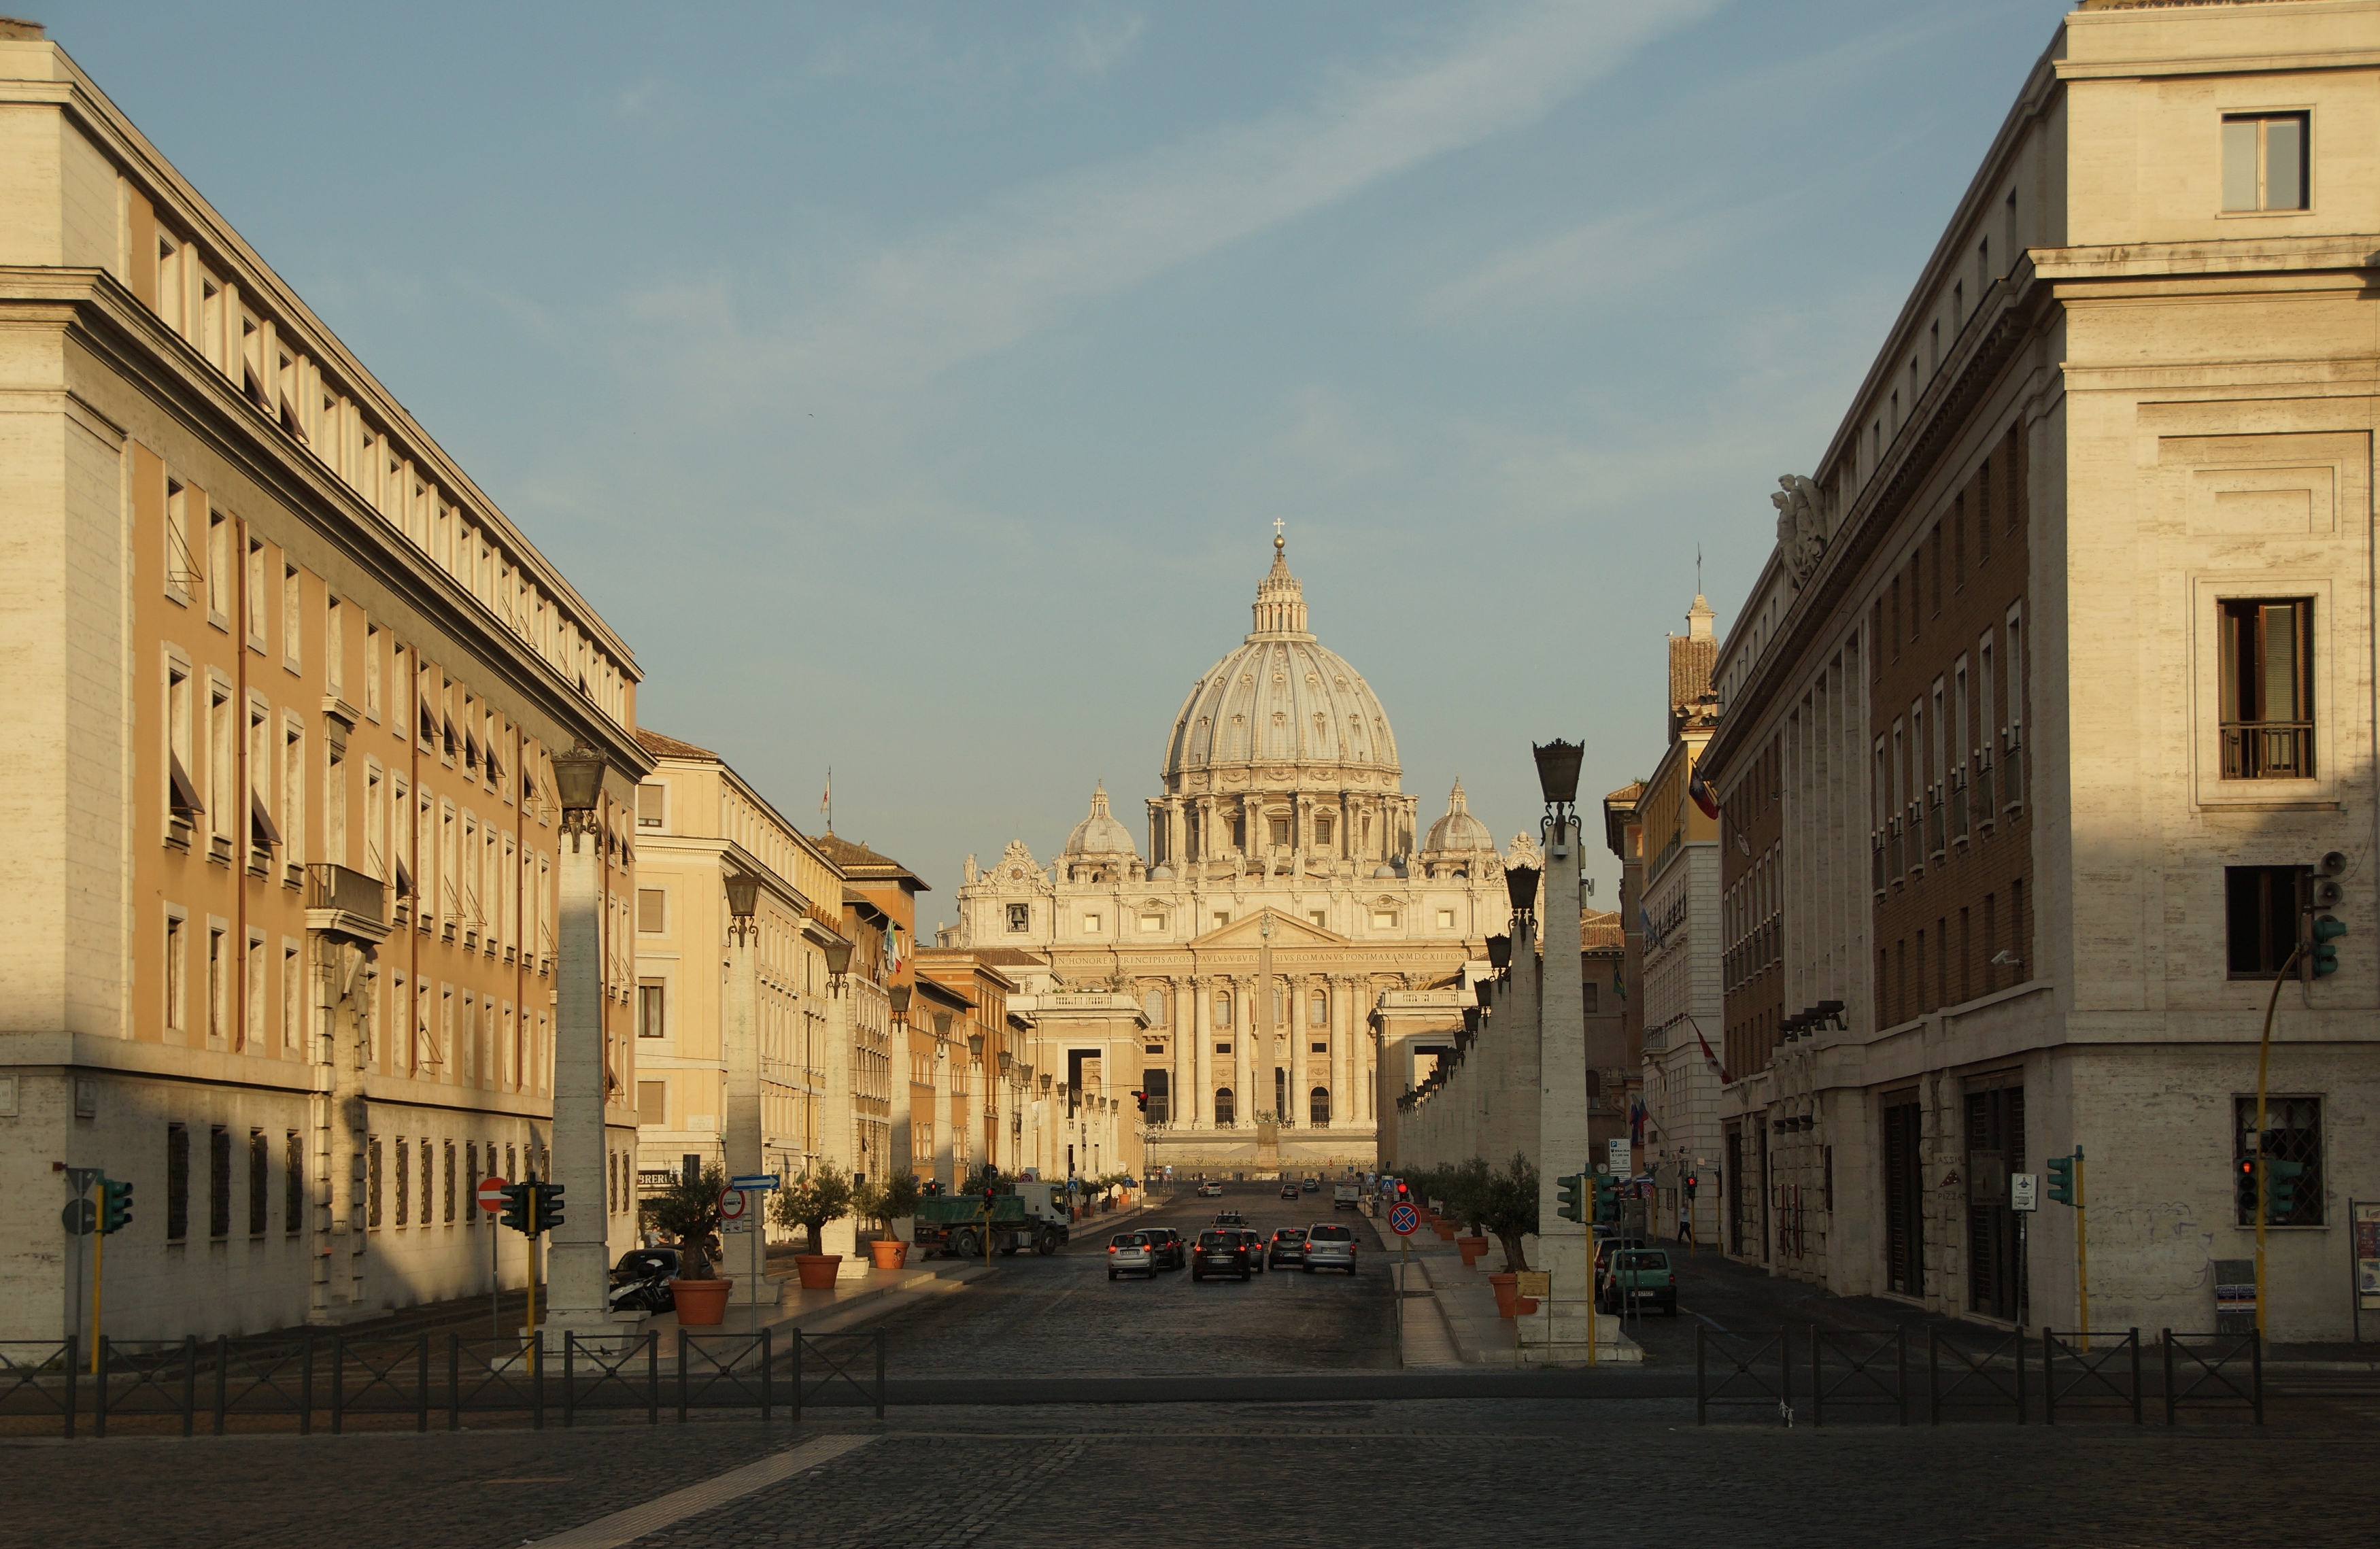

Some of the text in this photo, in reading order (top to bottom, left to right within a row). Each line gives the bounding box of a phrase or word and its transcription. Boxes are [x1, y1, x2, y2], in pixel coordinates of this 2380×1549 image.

[1119, 956, 1166, 964] PRINCIPIS
[1167, 955, 1195, 964] APOST
[1196, 955, 1228, 963] PAVLVS
[1296, 953, 1344, 961] ROMANVS
[1938, 1193, 1963, 1201] PIZZA
